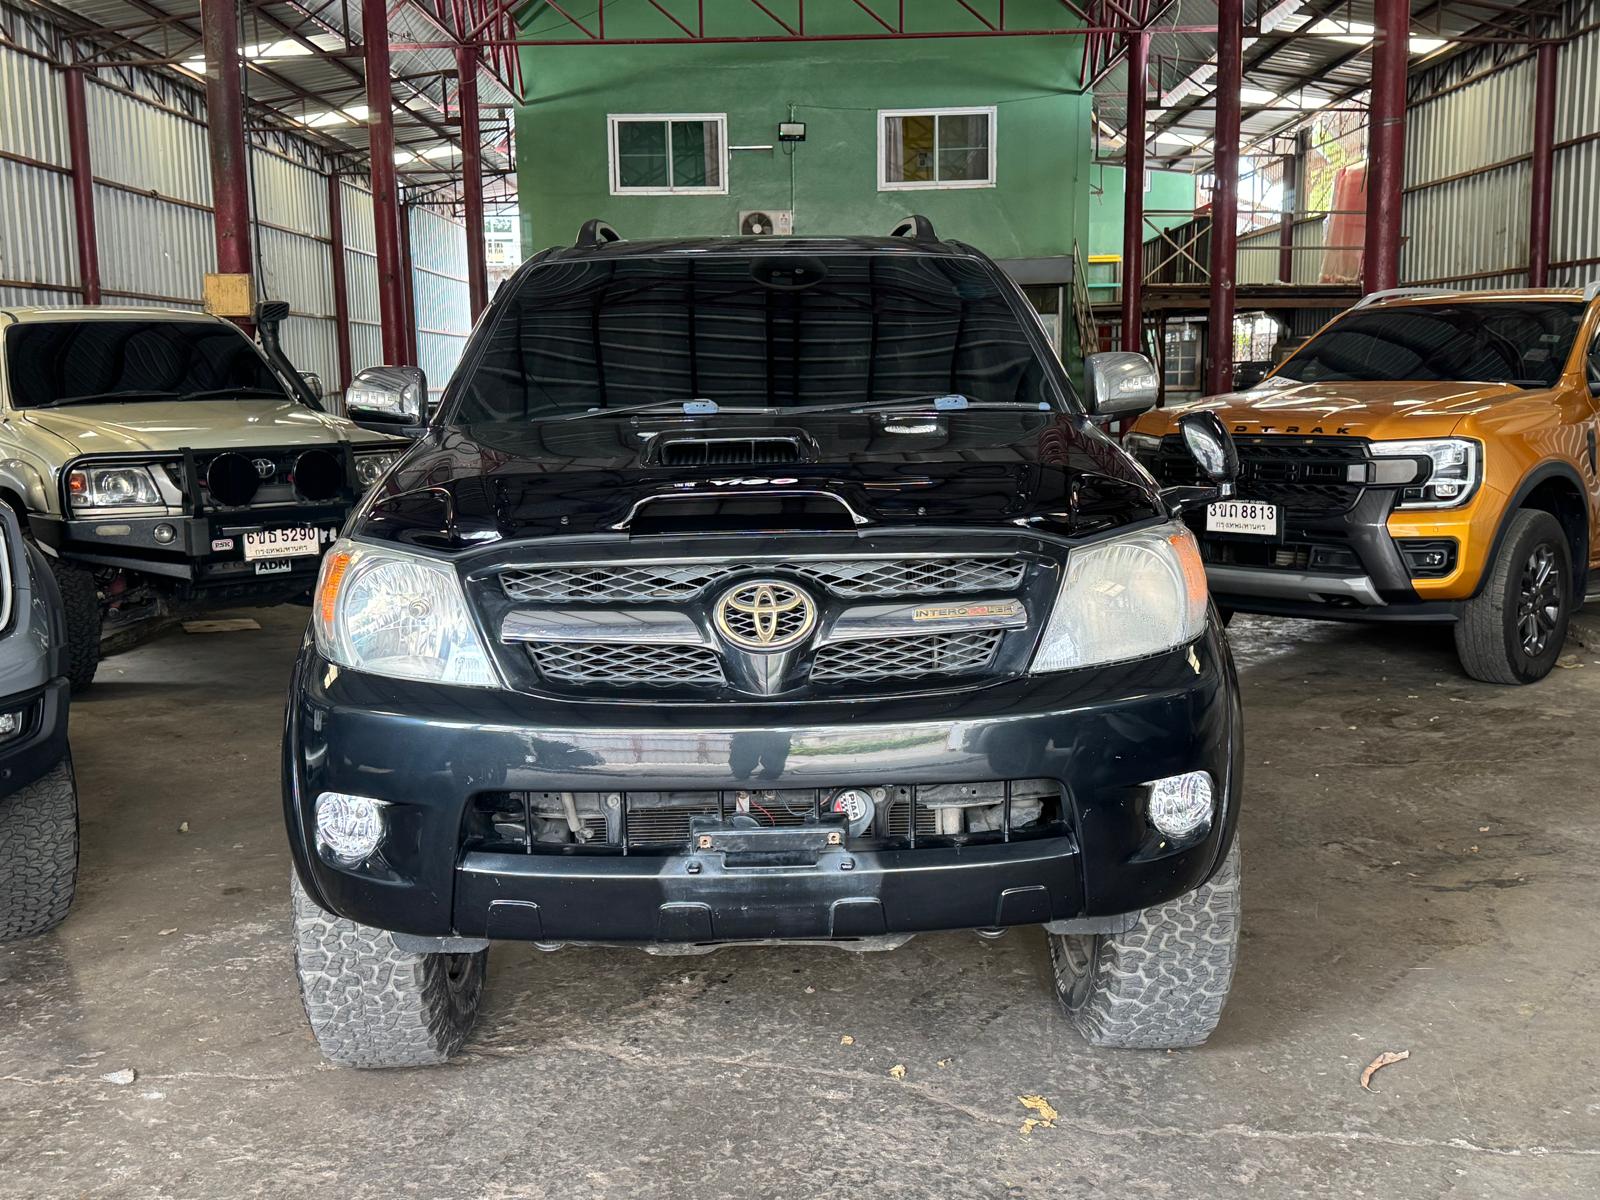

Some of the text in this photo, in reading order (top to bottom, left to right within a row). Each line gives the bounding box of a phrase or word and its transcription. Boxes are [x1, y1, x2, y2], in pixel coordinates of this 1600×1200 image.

[1234, 425, 1351, 435] DTRAK
[1241, 505, 1274, 520] 8813
[281, 527, 315, 542] 5290
[259, 560, 289, 571] ADM
[915, 605, 1013, 617] INTERCLER
[848, 793, 858, 818] PIAA
